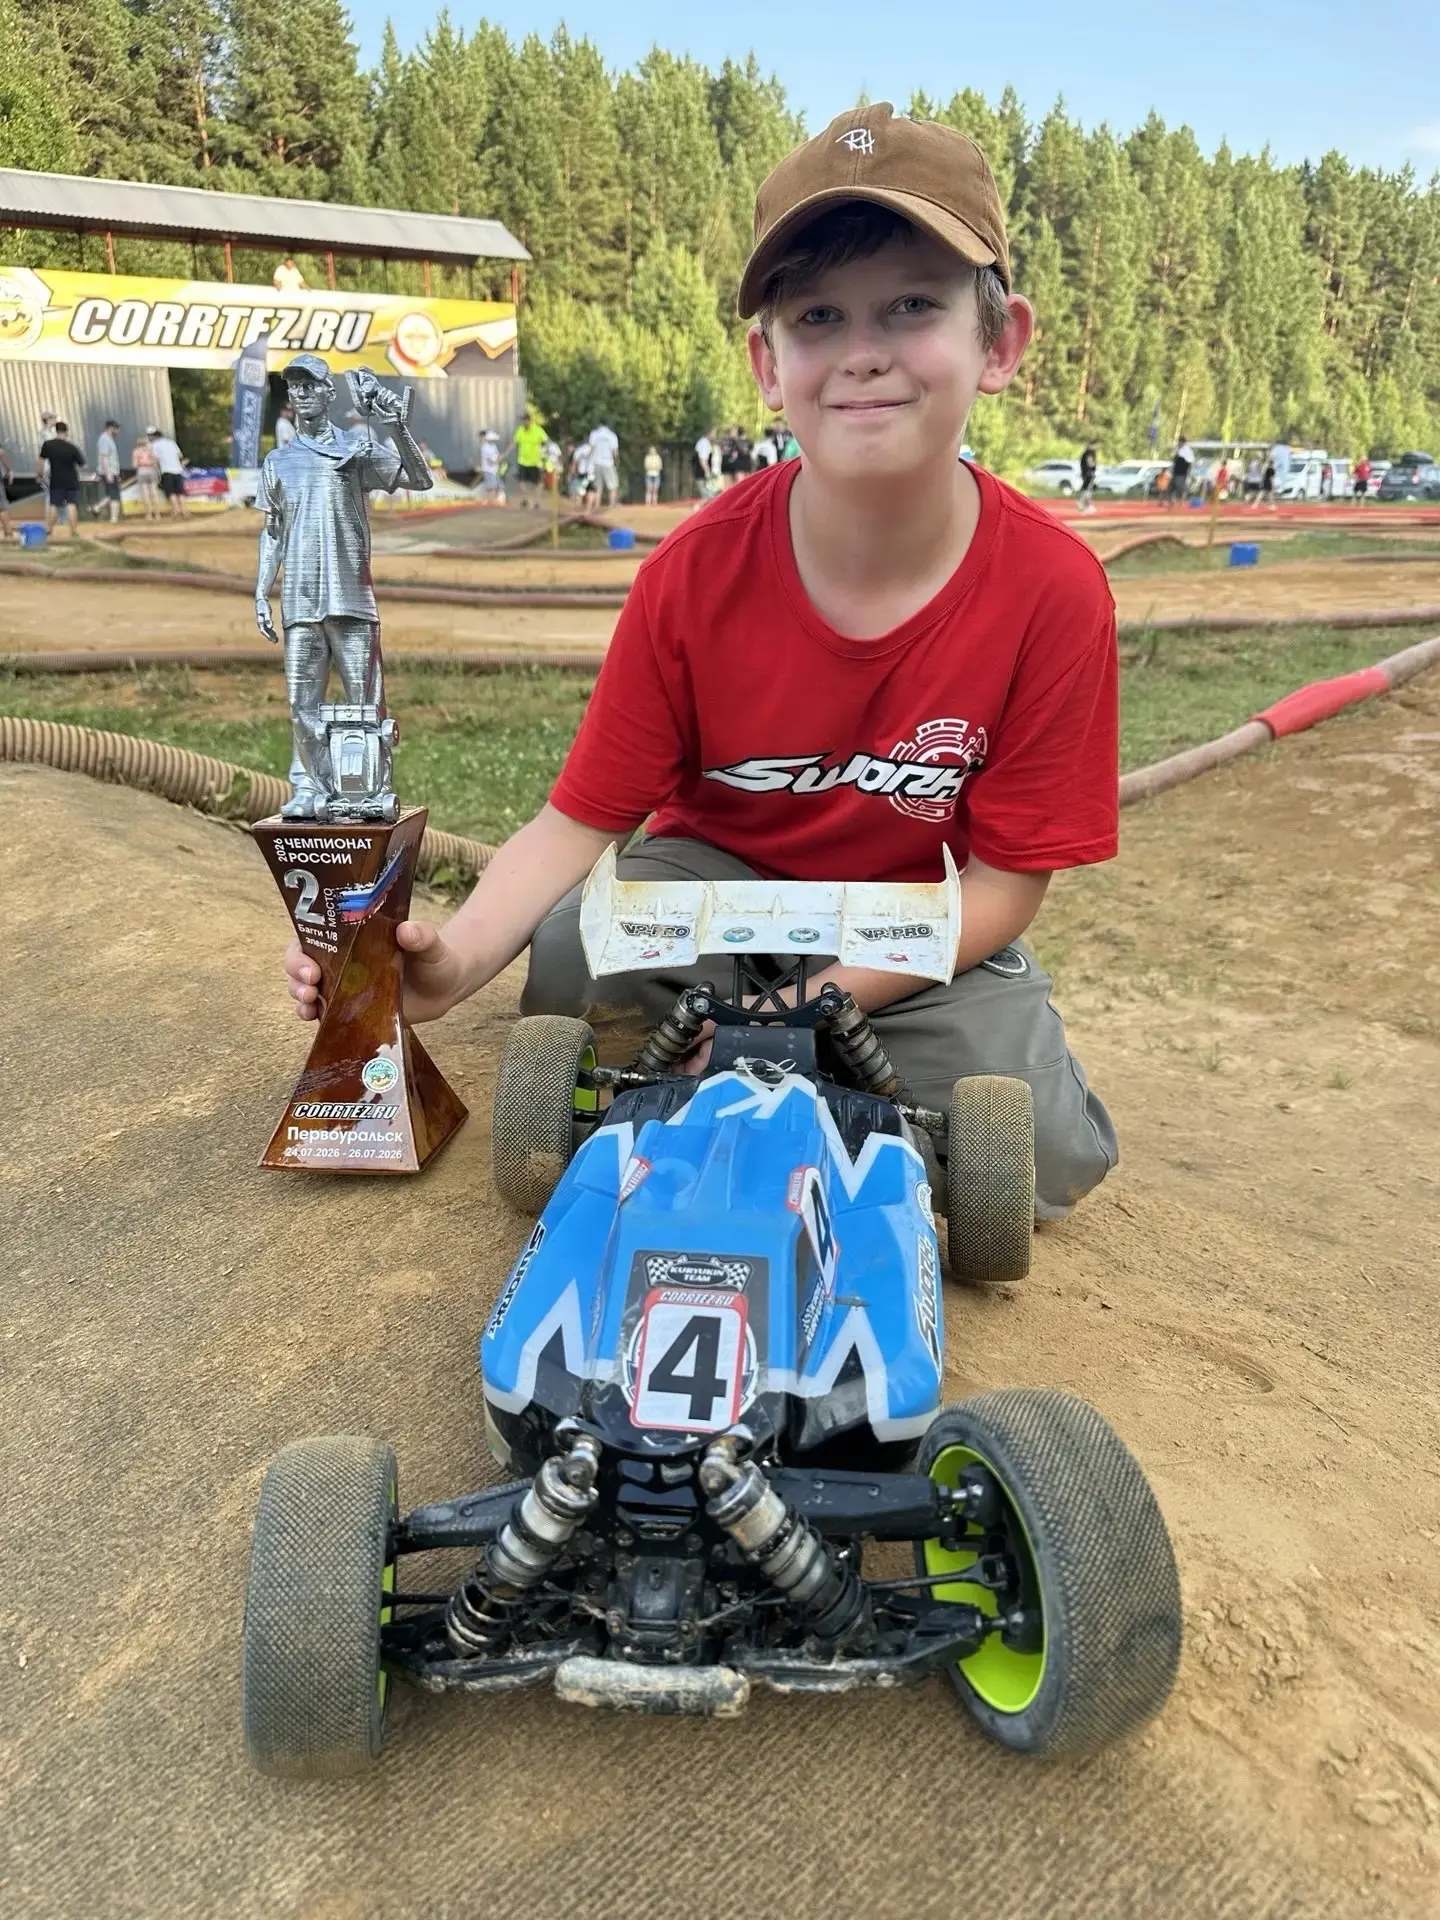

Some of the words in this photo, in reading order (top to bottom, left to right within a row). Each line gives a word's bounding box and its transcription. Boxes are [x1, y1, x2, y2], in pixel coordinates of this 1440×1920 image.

[69, 297, 374, 352] CORRTEZ.RU
[273, 838, 288, 862] 2026
[284, 838, 372, 850] ЧЕМПИОНАТ
[288, 852, 352, 864] РОССИИ
[284, 868, 325, 926] 2
[323, 888, 337, 928] место
[298, 923, 323, 937] Багги
[325, 930, 338, 941] 1/8
[305, 937, 338, 953] электро
[292, 1103, 400, 1119] CORRTEZ.RU
[287, 1126, 403, 1144] Первоуральск
[286, 1148, 340, 1158] 24.07.2026
[348, 1149, 403, 1159] 26.07.2026
[811, 1177, 834, 1269] 4
[669, 1266, 725, 1277] KURYUKIN
[683, 1274, 712, 1282] TEAM
[659, 1291, 735, 1306] CORRTEZ.RU
[647, 1315, 729, 1422] 4
